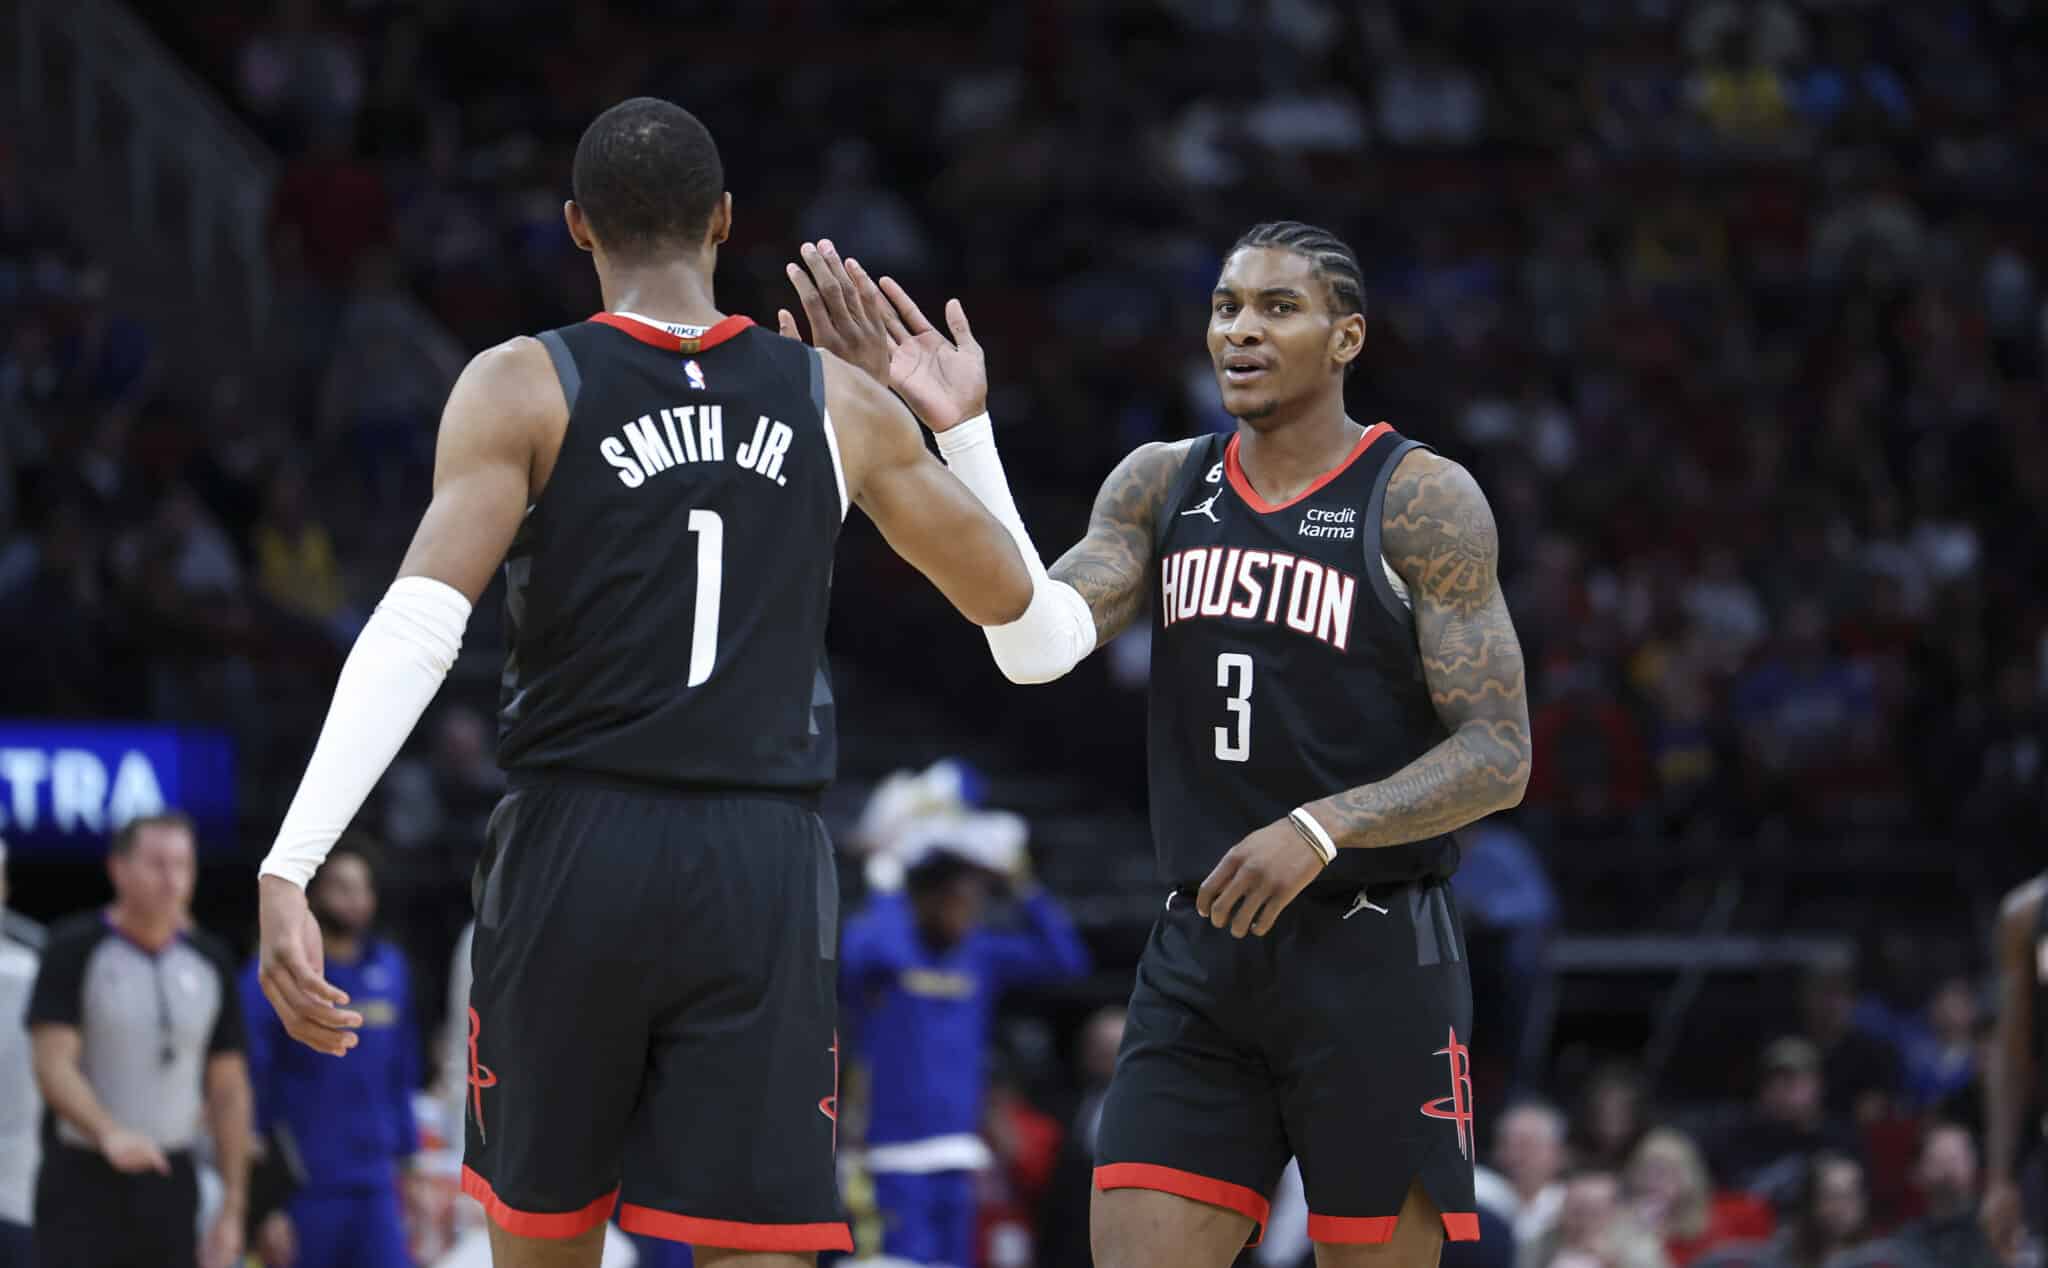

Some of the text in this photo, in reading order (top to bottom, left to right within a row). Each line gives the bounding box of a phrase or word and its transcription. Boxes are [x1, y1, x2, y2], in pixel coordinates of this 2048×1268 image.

[666, 325, 697, 336] NIKE
[600, 405, 793, 488] SMITH JR.
[1205, 461, 1223, 482] 6
[1298, 520, 1355, 539] karma
[1306, 507, 1356, 523] credit
[687, 509, 723, 687] 1
[1161, 547, 1357, 652] HOUSTON
[1214, 652, 1253, 762] 3
[0, 748, 165, 832] TRA
